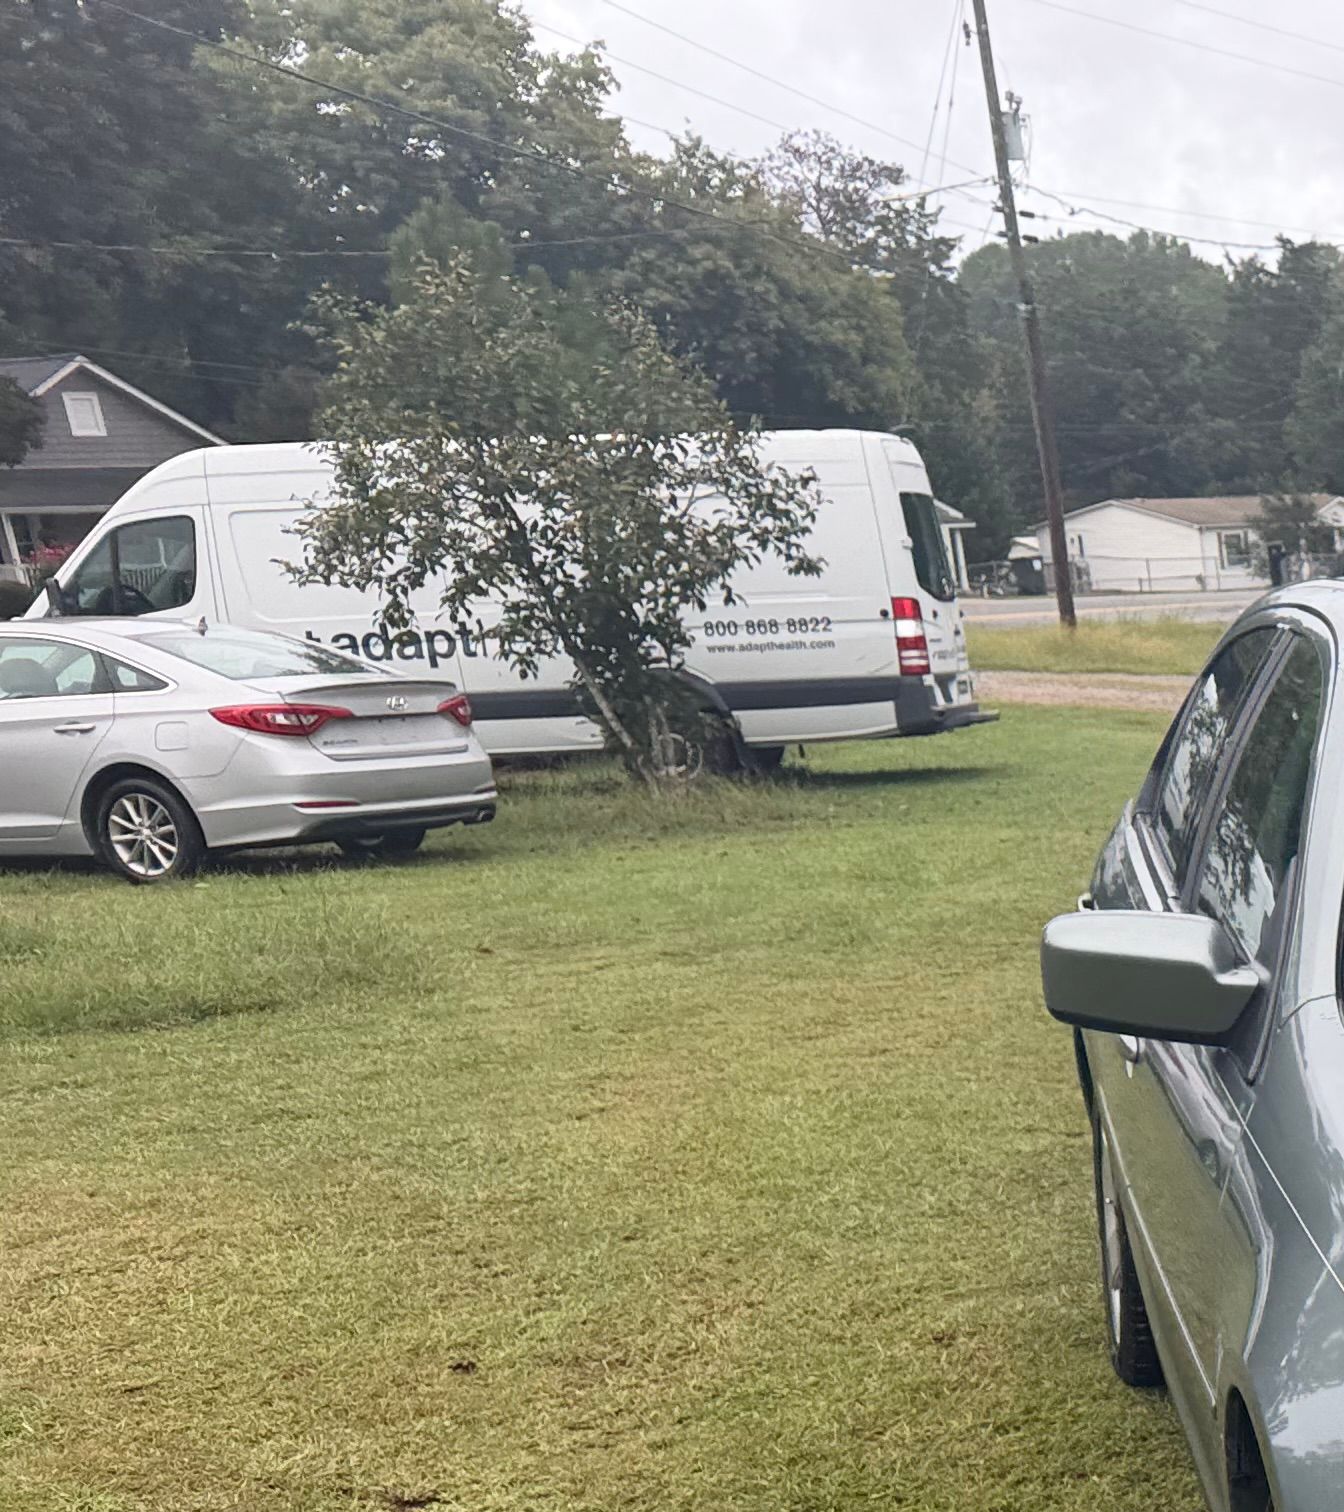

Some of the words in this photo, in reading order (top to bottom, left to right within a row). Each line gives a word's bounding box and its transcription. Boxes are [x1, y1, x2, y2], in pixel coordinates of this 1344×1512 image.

[704, 620, 739, 637] 800
[745, 619, 779, 635] 868
[786, 616, 832, 634] 8822
[706, 639, 836, 654] www.adapthealth.com
